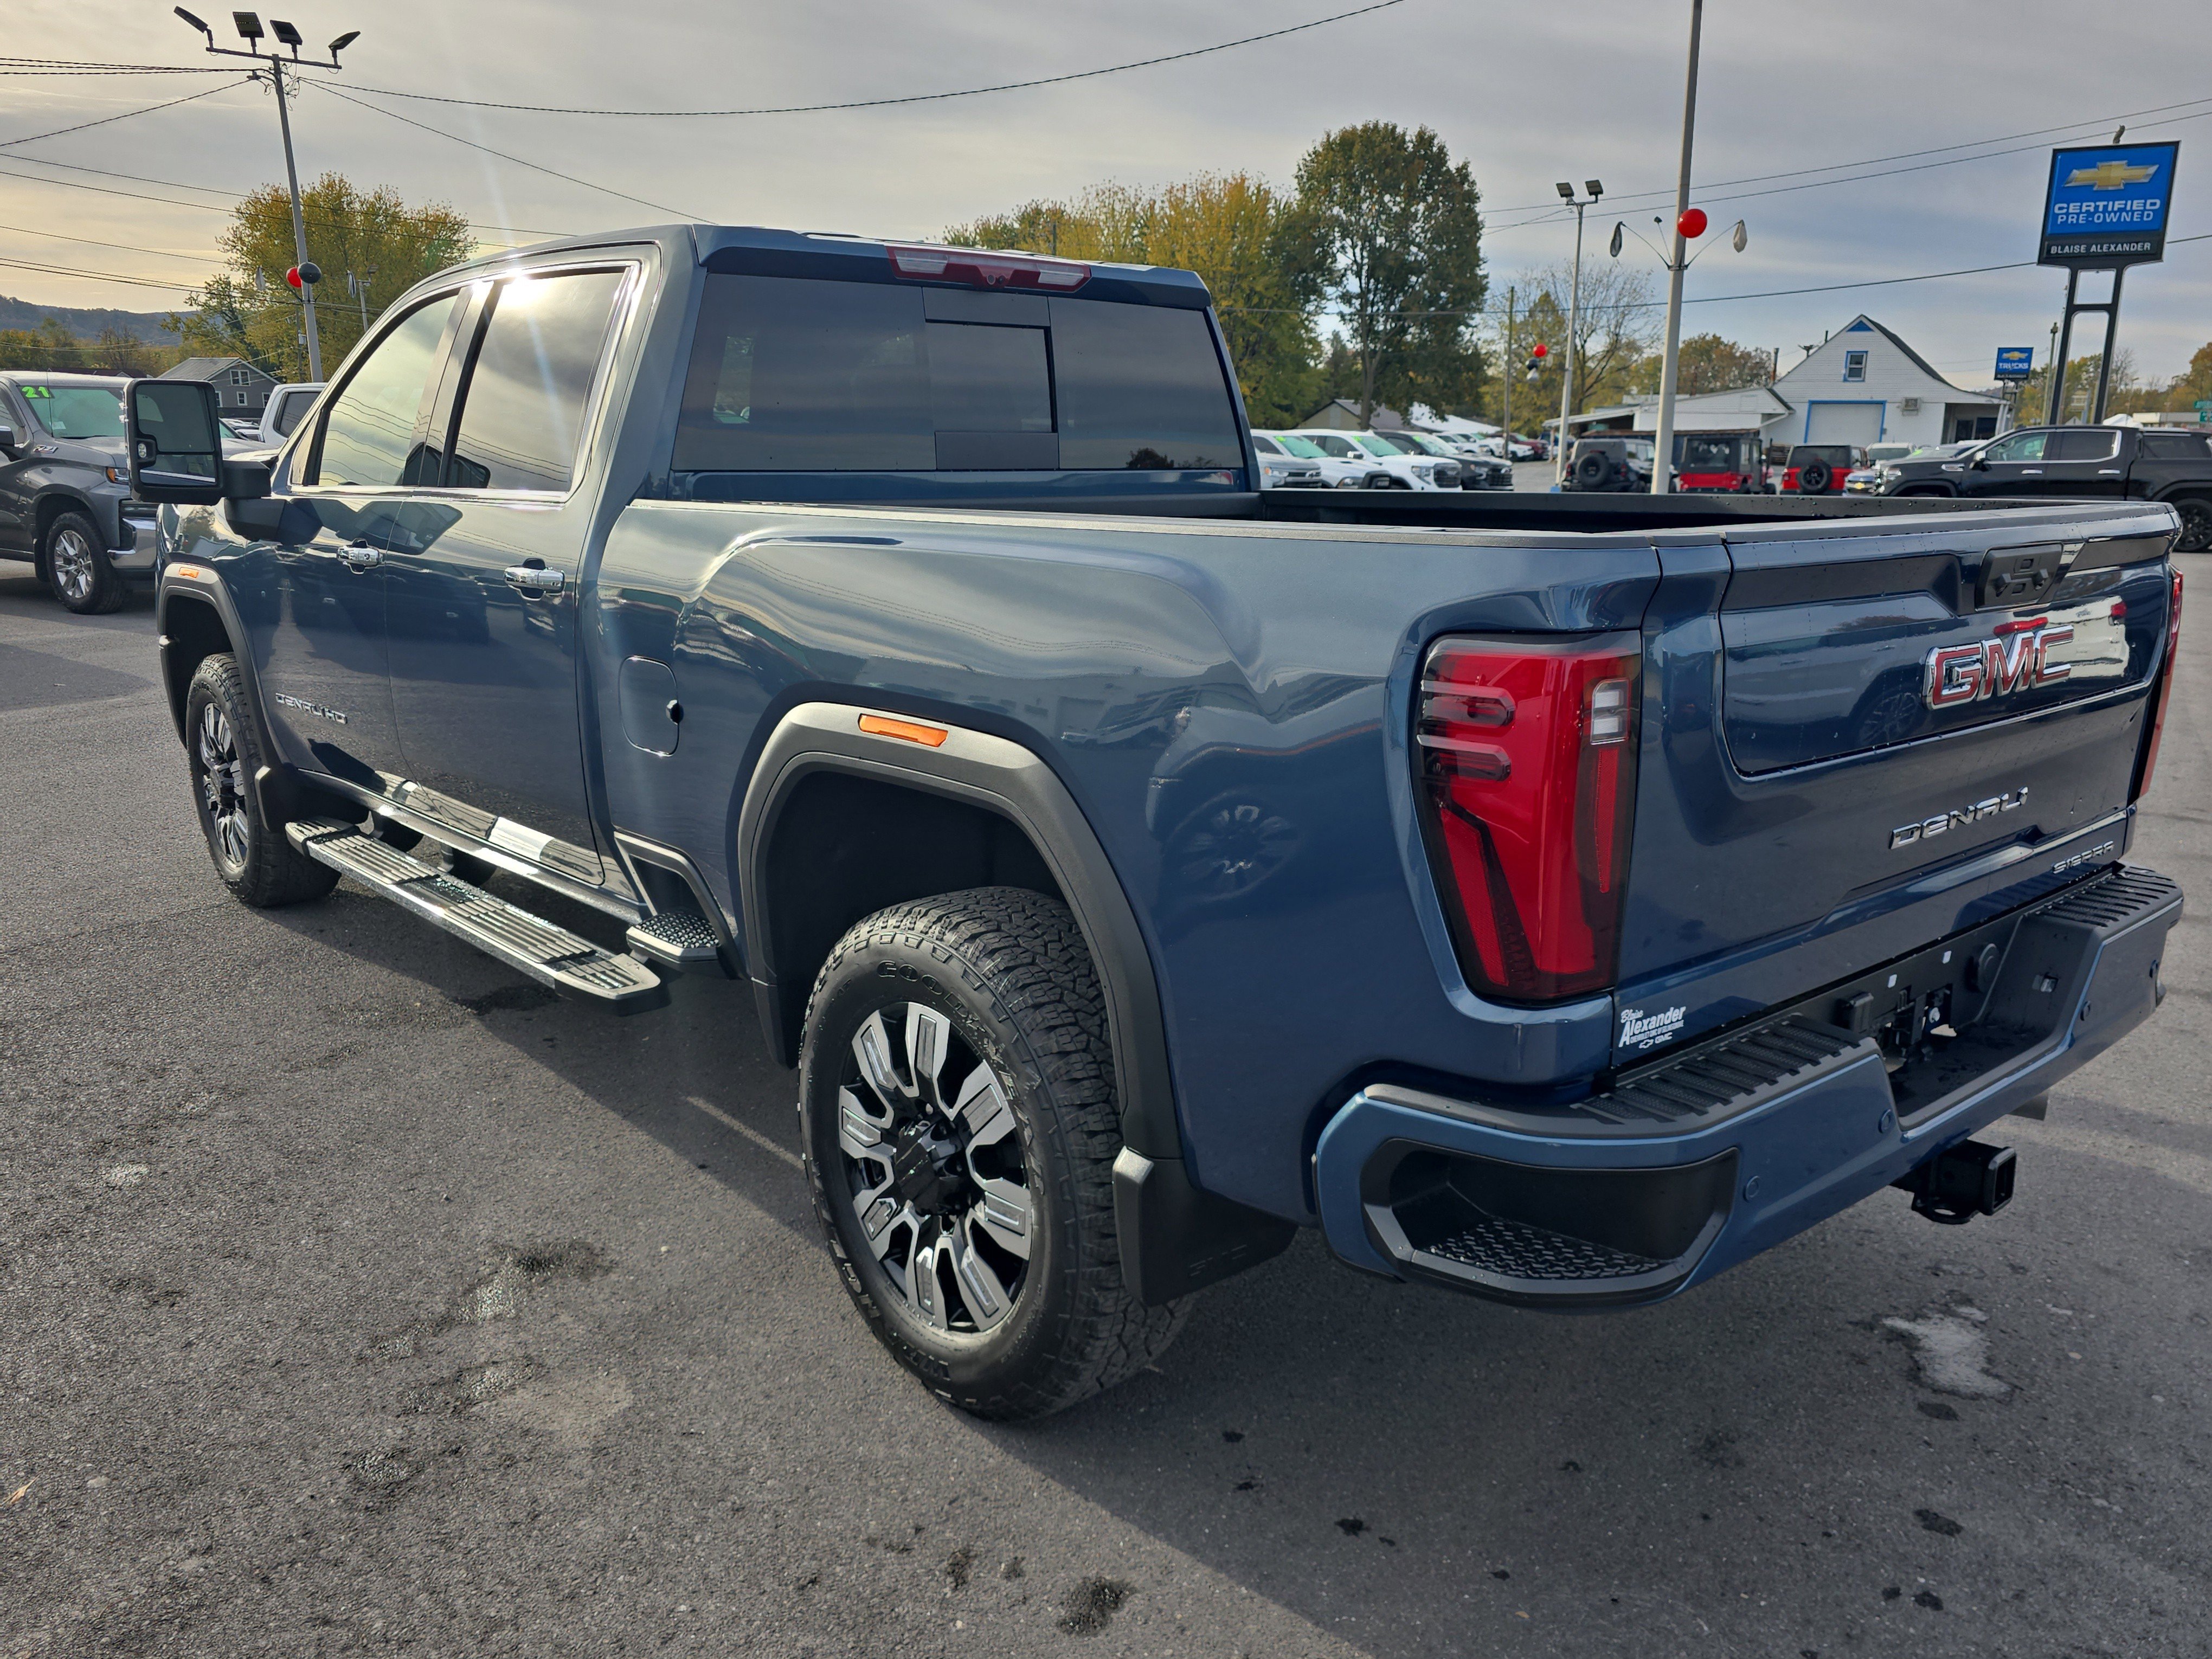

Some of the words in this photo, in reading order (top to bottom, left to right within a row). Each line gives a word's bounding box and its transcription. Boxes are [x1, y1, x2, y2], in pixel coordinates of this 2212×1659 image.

[2054, 199, 2160, 214] CERTIFIED
[2057, 211, 2153, 224] PRE-OWNED
[2050, 245, 2087, 254] BLAISE
[2090, 242, 2151, 252] ALEXANDER
[22, 386, 52, 398] 21
[1922, 625, 2074, 710] GMC
[275, 693, 325, 717] DENALI
[1889, 787, 2028, 850] DENALI
[2052, 840, 2115, 873] SIERRA
[1618, 1006, 1686, 1047] Alexander
